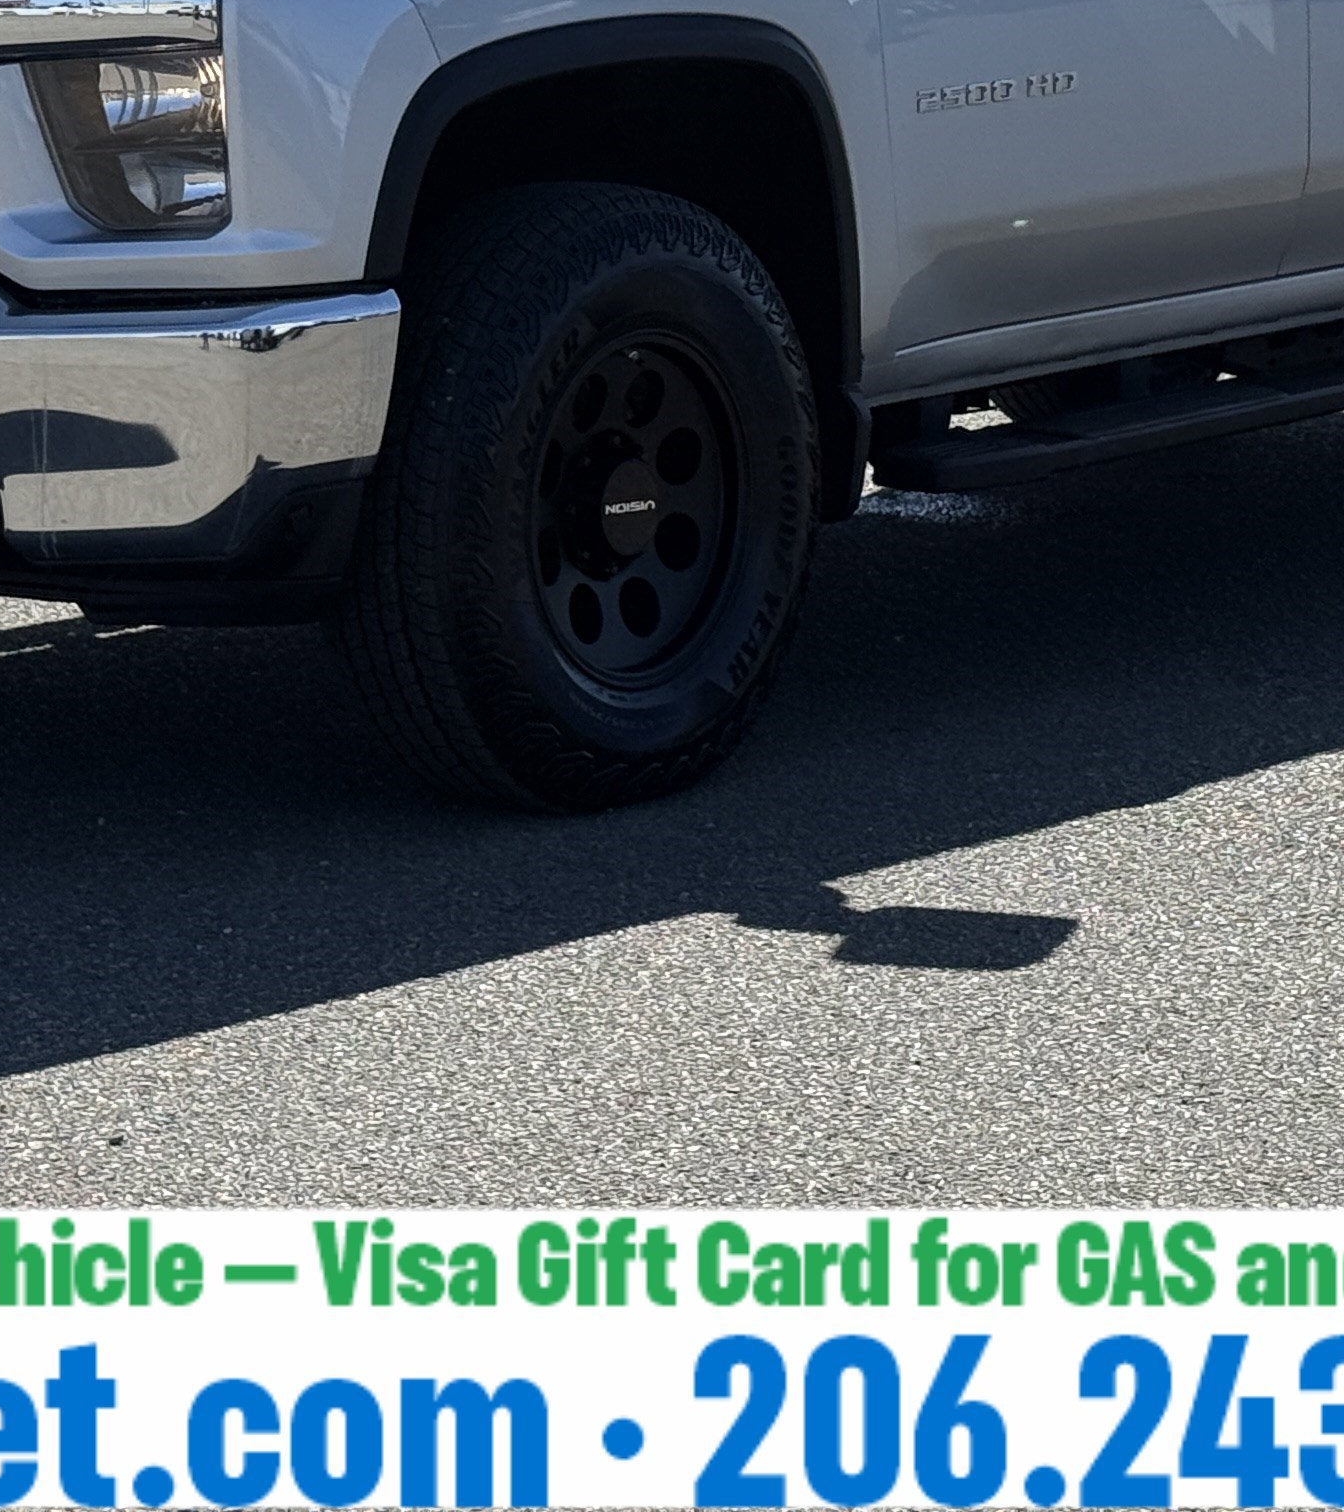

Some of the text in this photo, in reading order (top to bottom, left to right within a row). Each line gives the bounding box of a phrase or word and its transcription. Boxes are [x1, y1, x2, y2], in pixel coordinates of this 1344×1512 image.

[916, 71, 1078, 114] 2500 HD
[604, 499, 656, 516] VISION
